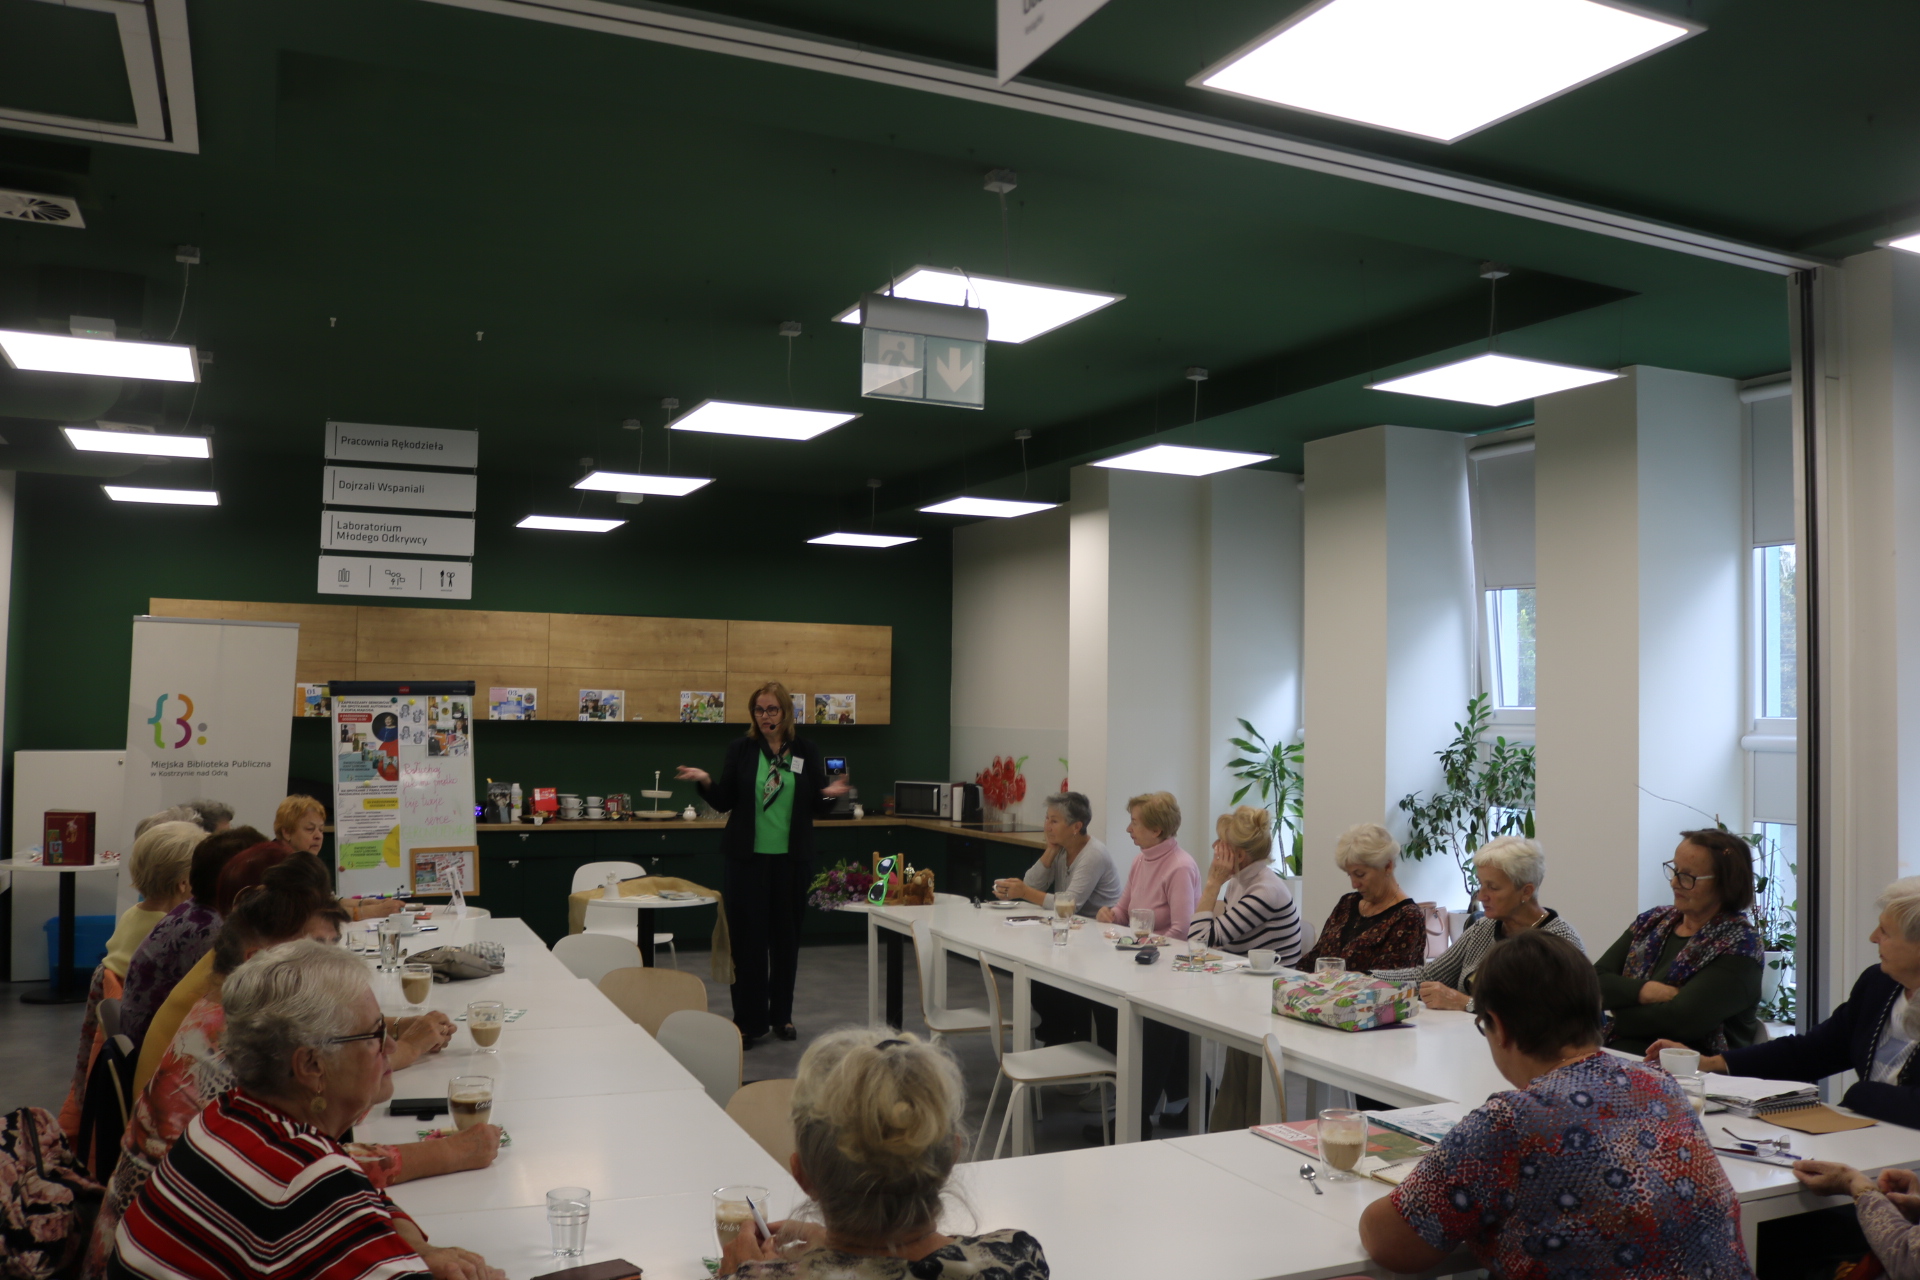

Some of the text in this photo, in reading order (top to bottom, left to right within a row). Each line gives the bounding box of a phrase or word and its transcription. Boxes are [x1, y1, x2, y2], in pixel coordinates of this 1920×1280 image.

[340, 435, 444, 451] Pracownia Rękodzieła
[338, 480, 425, 494] Dojrzali Wspaniali
[336, 521, 402, 533] Laboratorium
[336, 531, 428, 546] Młodego Odkrywcy
[151, 760, 271, 770] Miejska Biblioteka Publiczna
[211, 770, 229, 778] Odrą
